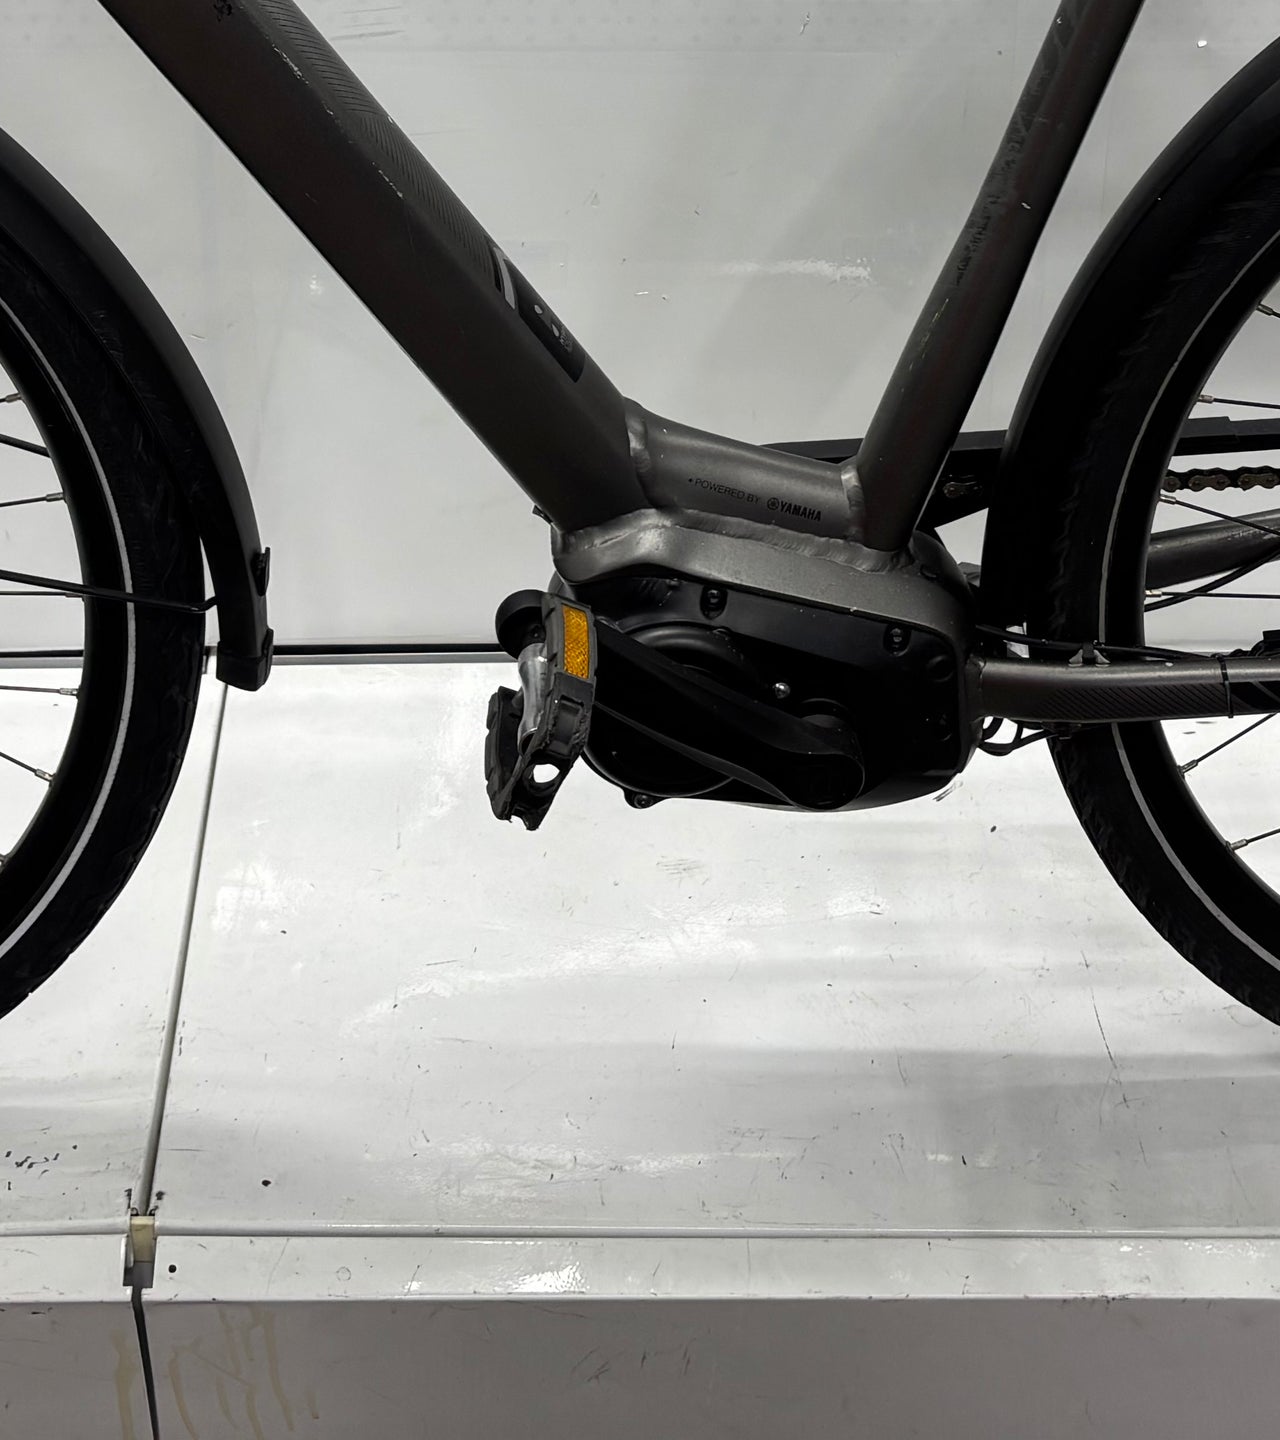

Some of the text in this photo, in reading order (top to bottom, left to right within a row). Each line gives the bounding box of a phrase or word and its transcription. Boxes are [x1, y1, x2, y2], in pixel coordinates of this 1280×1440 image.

[694, 478, 822, 522] POWERED BY YAMAHA
